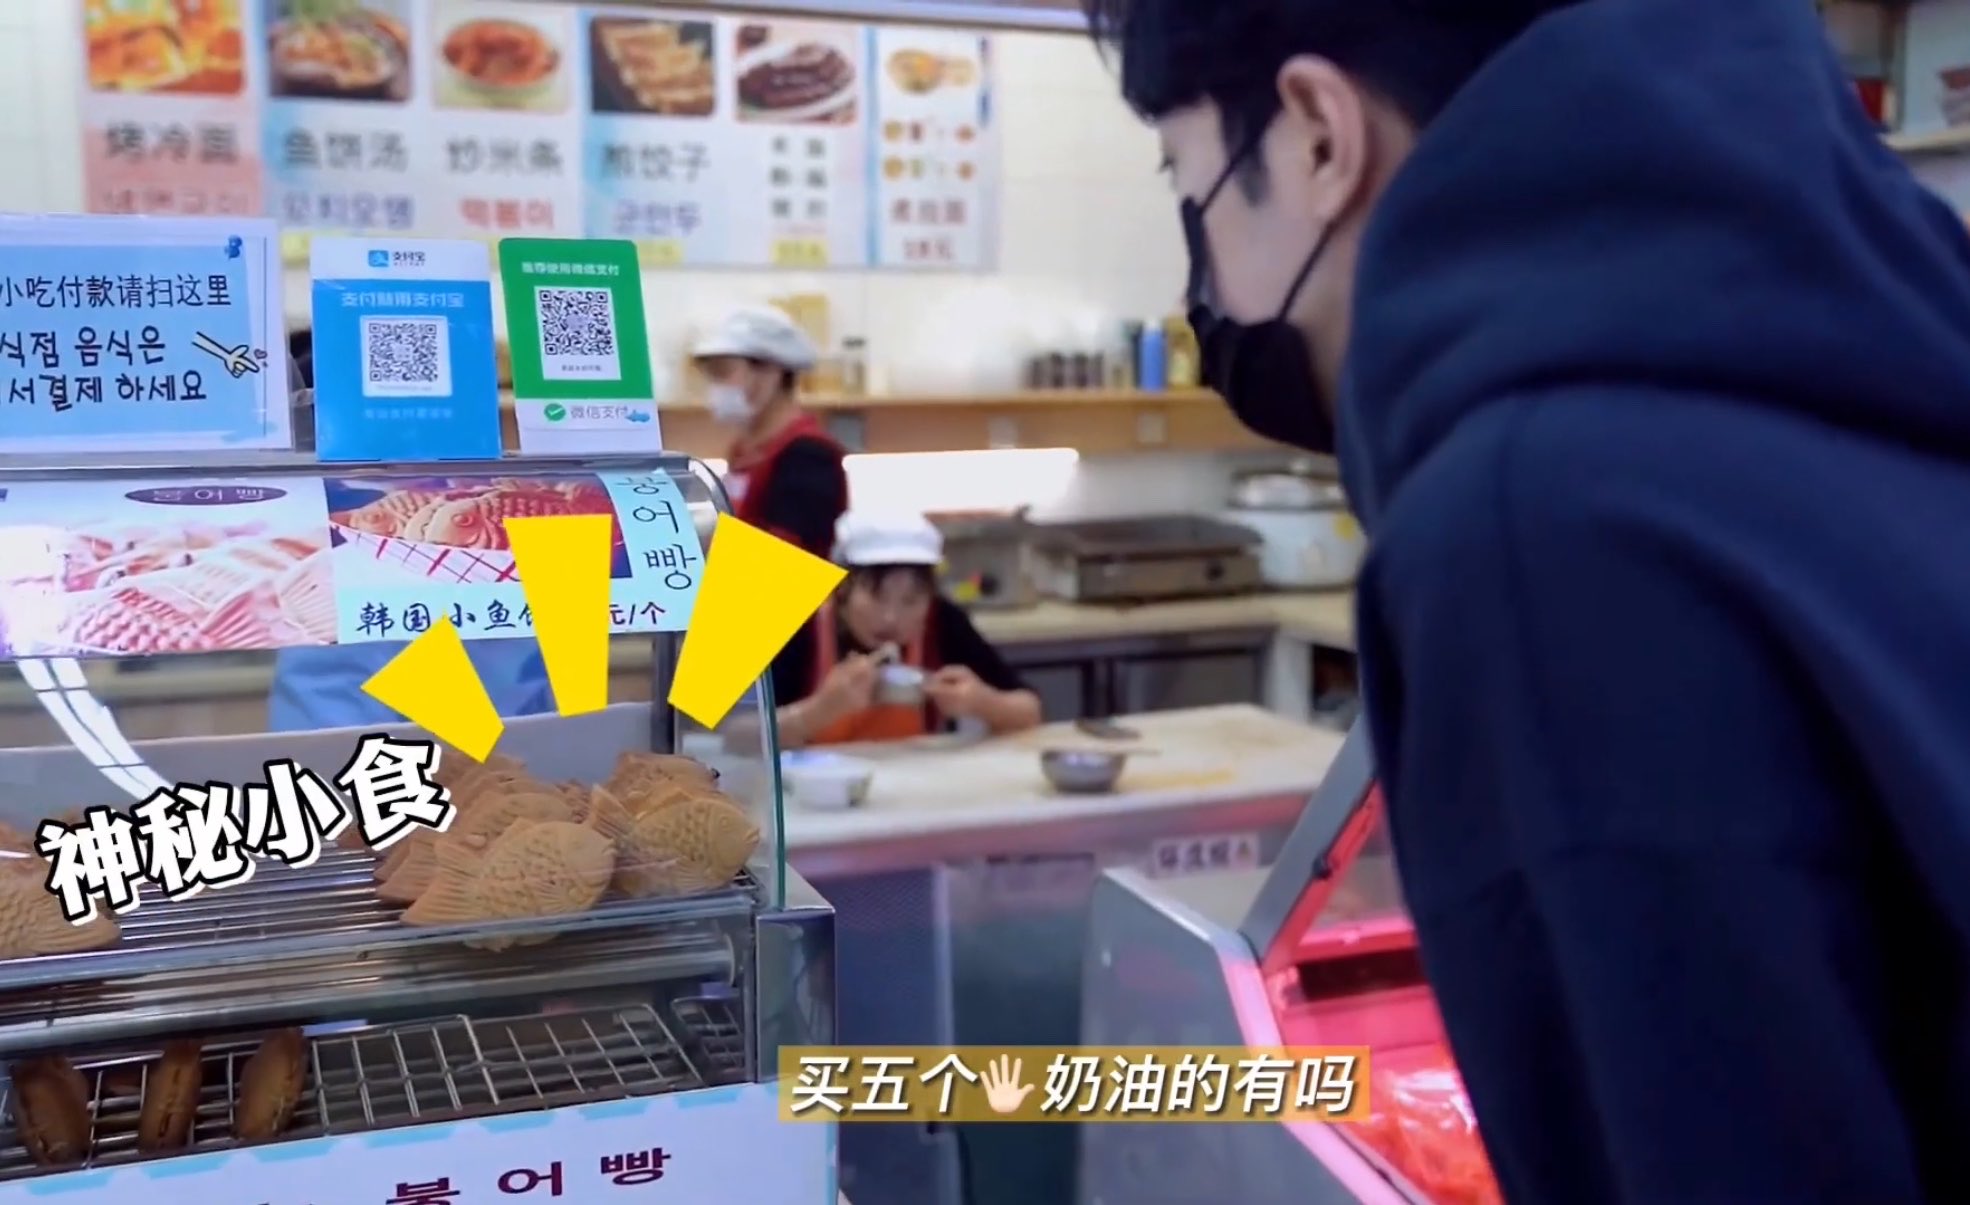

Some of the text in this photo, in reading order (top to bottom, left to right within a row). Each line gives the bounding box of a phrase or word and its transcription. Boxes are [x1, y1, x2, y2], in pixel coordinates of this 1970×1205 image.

[0, 274, 232, 308] 小吃付款请扫这里
[75, 325, 165, 366] 음식은
[115, 370, 207, 401] 하세요
[356, 598, 533, 637] 韩国小鱼
